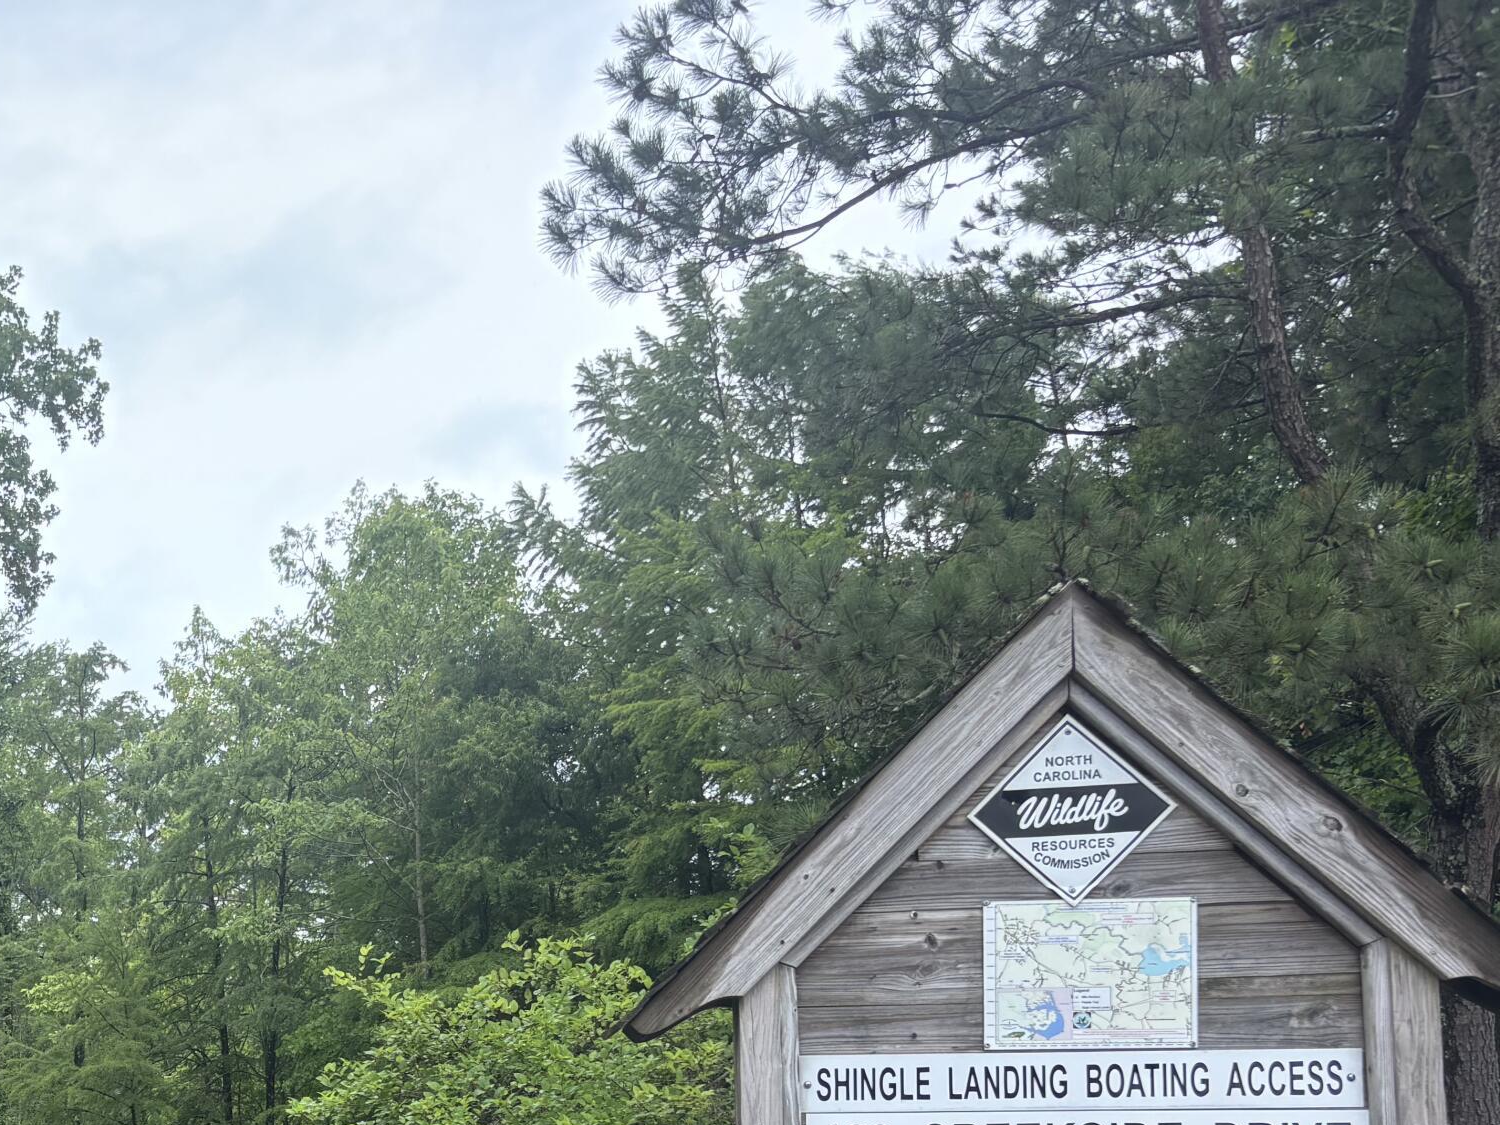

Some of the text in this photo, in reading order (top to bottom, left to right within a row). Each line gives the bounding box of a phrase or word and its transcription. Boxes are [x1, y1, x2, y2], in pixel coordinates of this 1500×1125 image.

[1045, 754, 1092, 767] NORTH
[1033, 769, 1101, 782] CAROLINA
[1017, 788, 1129, 831] Wildlife
[1032, 838, 1115, 852] RESOURCES
[1034, 851, 1111, 869] COMMISSION
[816, 1060, 1344, 1101] SHINGLE LANDING BOATING ACCESS
